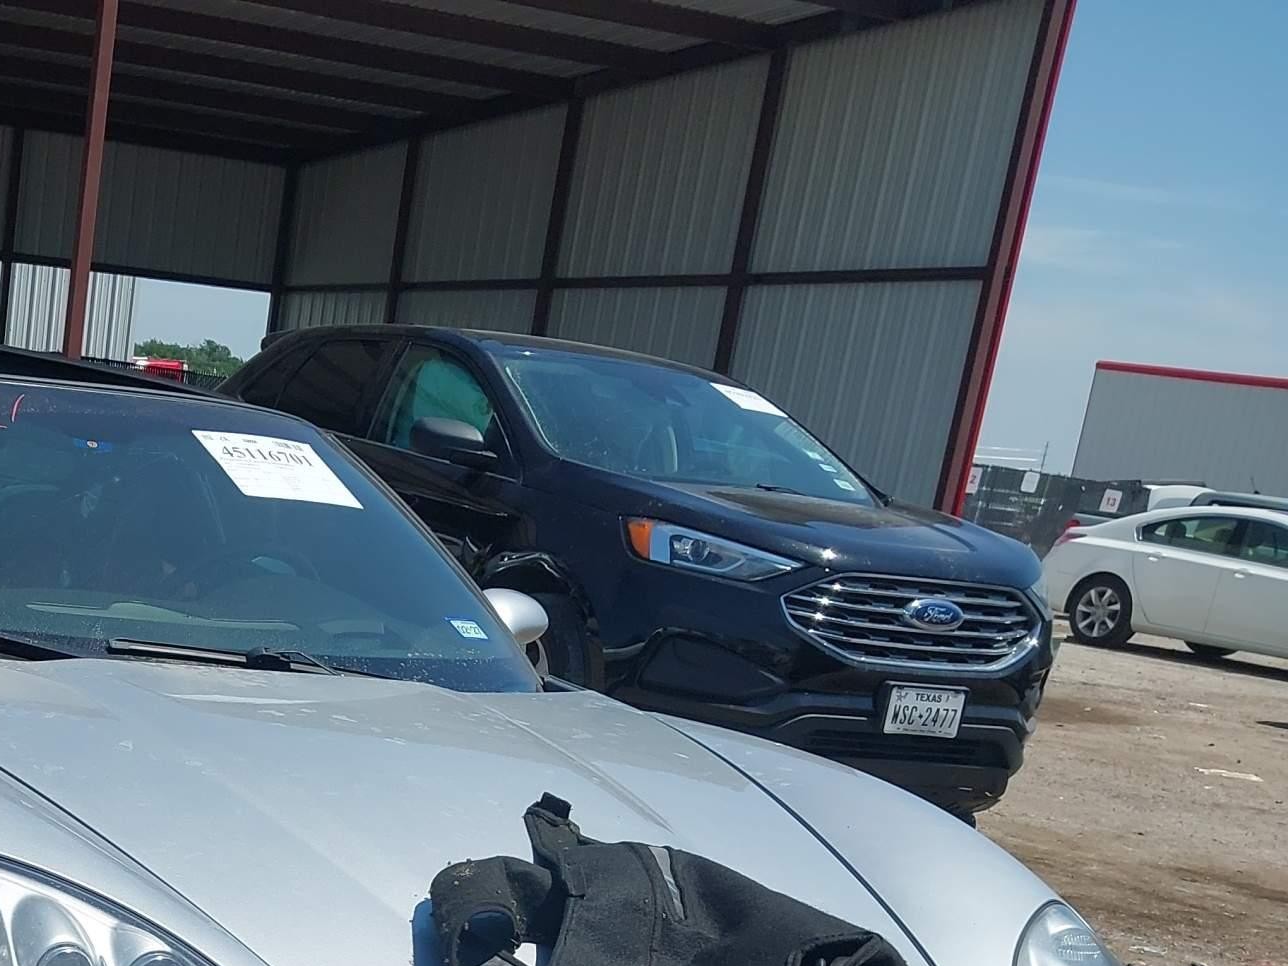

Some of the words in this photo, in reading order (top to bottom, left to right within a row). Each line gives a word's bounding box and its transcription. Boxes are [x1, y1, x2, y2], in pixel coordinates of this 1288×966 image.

[221, 445, 313, 467] 45116701
[923, 606, 954, 623] Ford
[915, 692, 943, 703] TEXAS
